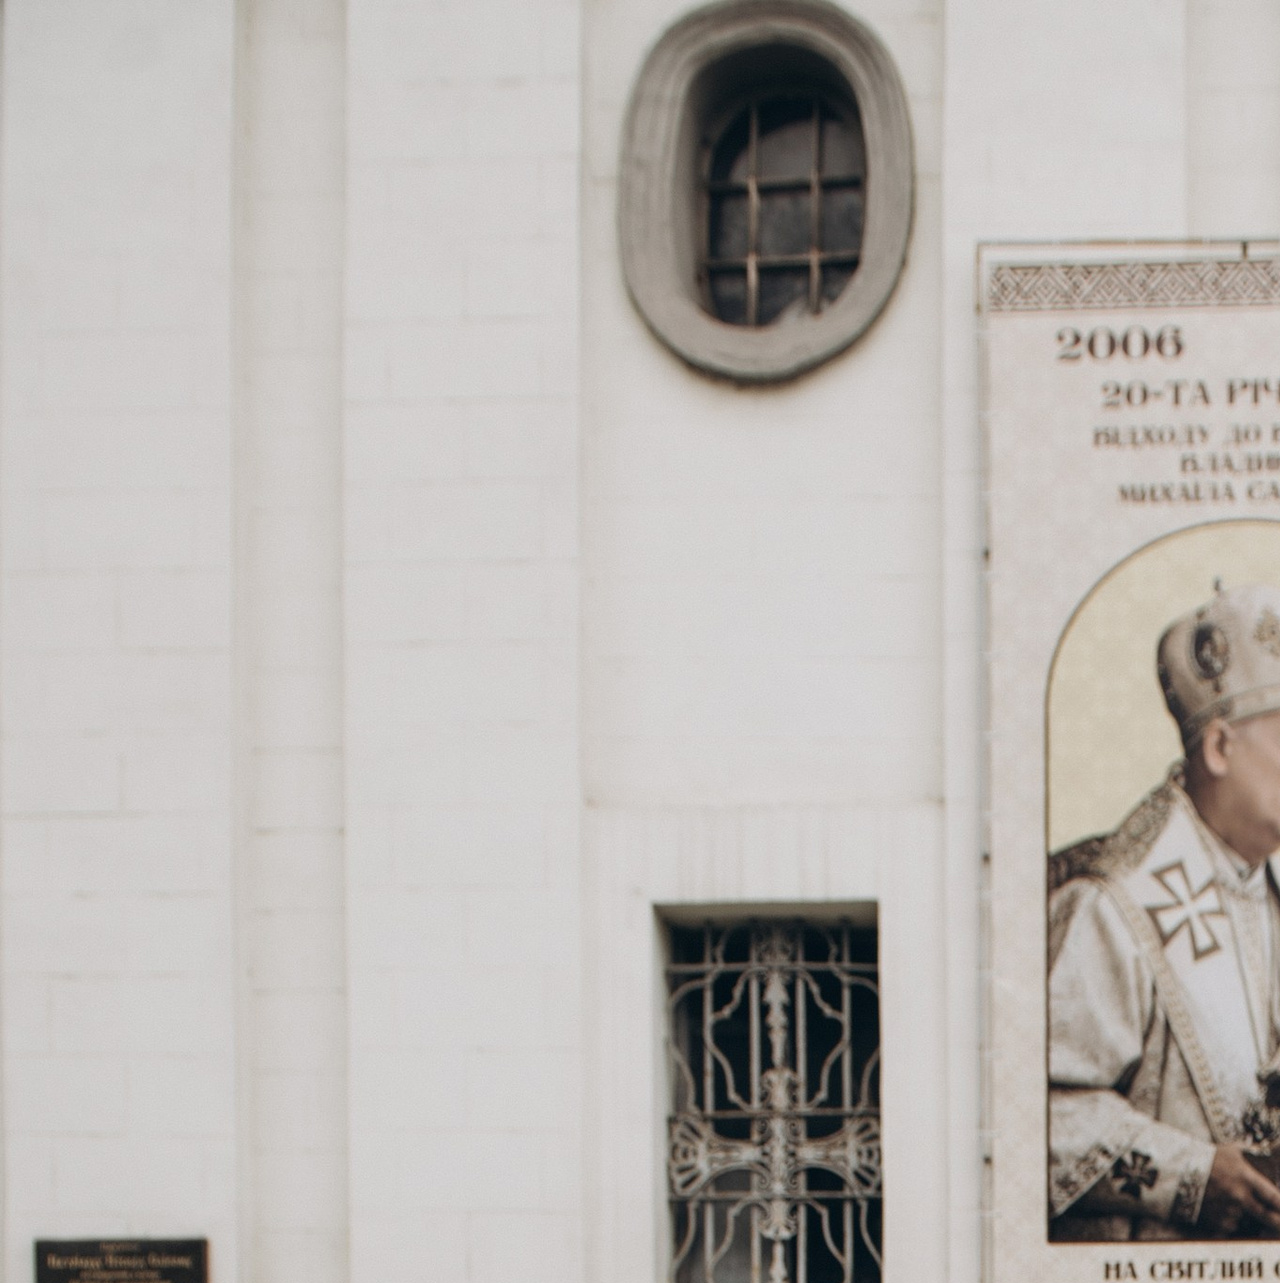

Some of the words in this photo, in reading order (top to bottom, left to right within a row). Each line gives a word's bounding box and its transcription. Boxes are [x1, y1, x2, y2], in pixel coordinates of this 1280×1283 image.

[1055, 325, 1185, 362] 2006
[1101, 379, 1211, 409] 20-ТА
[1103, 1260, 1138, 1282] НА
[1149, 1255, 1264, 1281] СВІТЛИЙ
